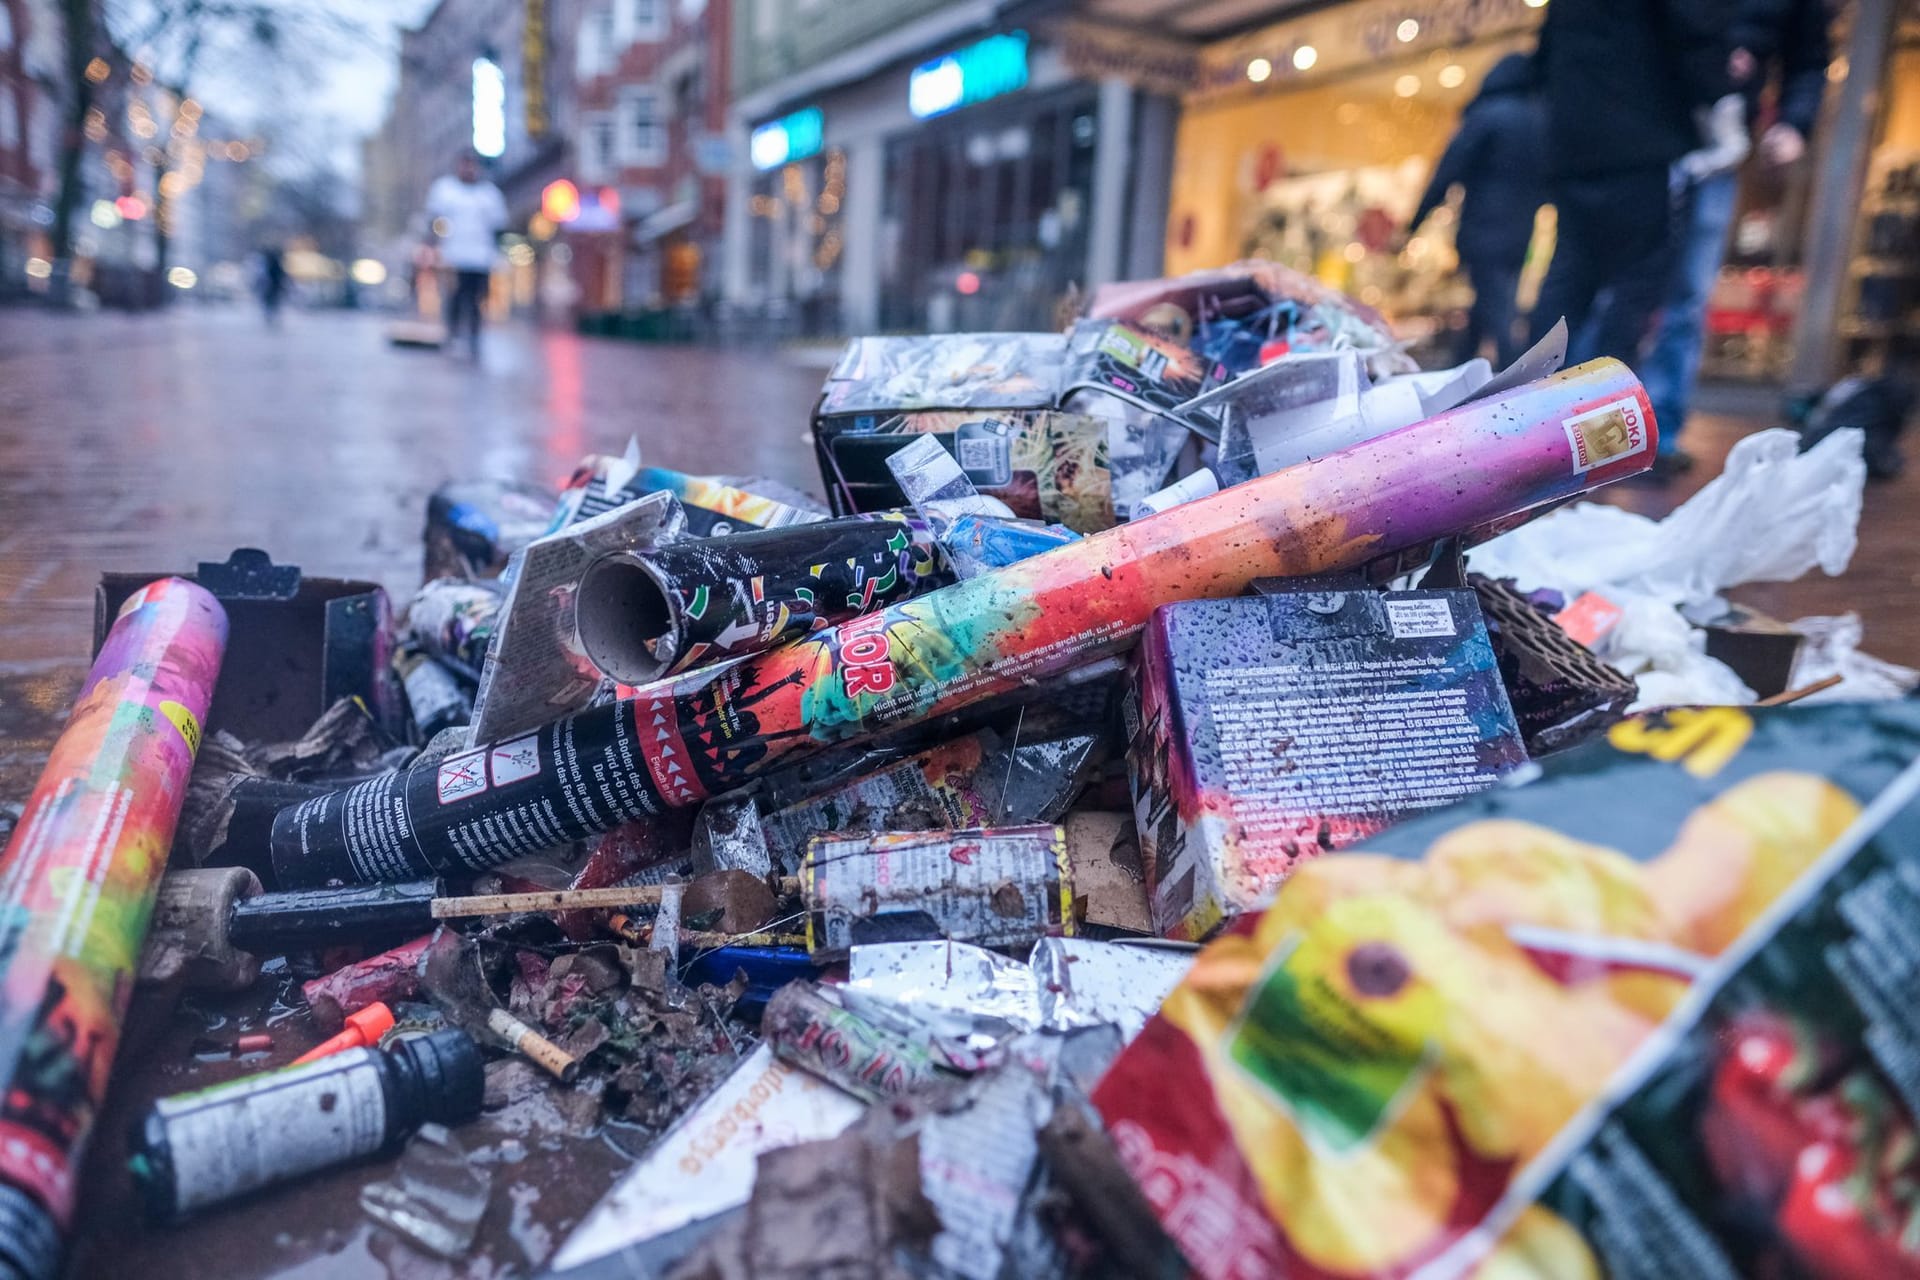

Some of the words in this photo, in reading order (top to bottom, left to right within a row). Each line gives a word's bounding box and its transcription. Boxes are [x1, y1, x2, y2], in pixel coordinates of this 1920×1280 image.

[1572, 424, 1587, 466] EDITION
[1622, 406, 1641, 449] JOKA
[760, 600, 774, 642] oben
[872, 699, 896, 712] Nicht
[898, 692, 913, 703] nur
[1019, 644, 1054, 660] sondern
[1112, 620, 1123, 628] an
[937, 683, 973, 700] Silvester
[1001, 662, 1033, 676] Wolken
[616, 723, 624, 737] am
[720, 722, 732, 738] grün
[554, 750, 564, 766] und
[564, 732, 582, 782] ungefährlich
[576, 783, 586, 795] für
[618, 738, 634, 770] Boden
[557, 767, 567, 784] das
[593, 764, 605, 781] Der
[600, 783, 616, 808] bunte
[604, 746, 619, 769] wird
[612, 771, 626, 788] 4-6
[619, 789, 629, 798] m
[624, 798, 634, 807] in
[629, 772, 642, 789] des
[394, 797, 409, 838] ACHTUNG!
[563, 784, 586, 823] Farbpulver
